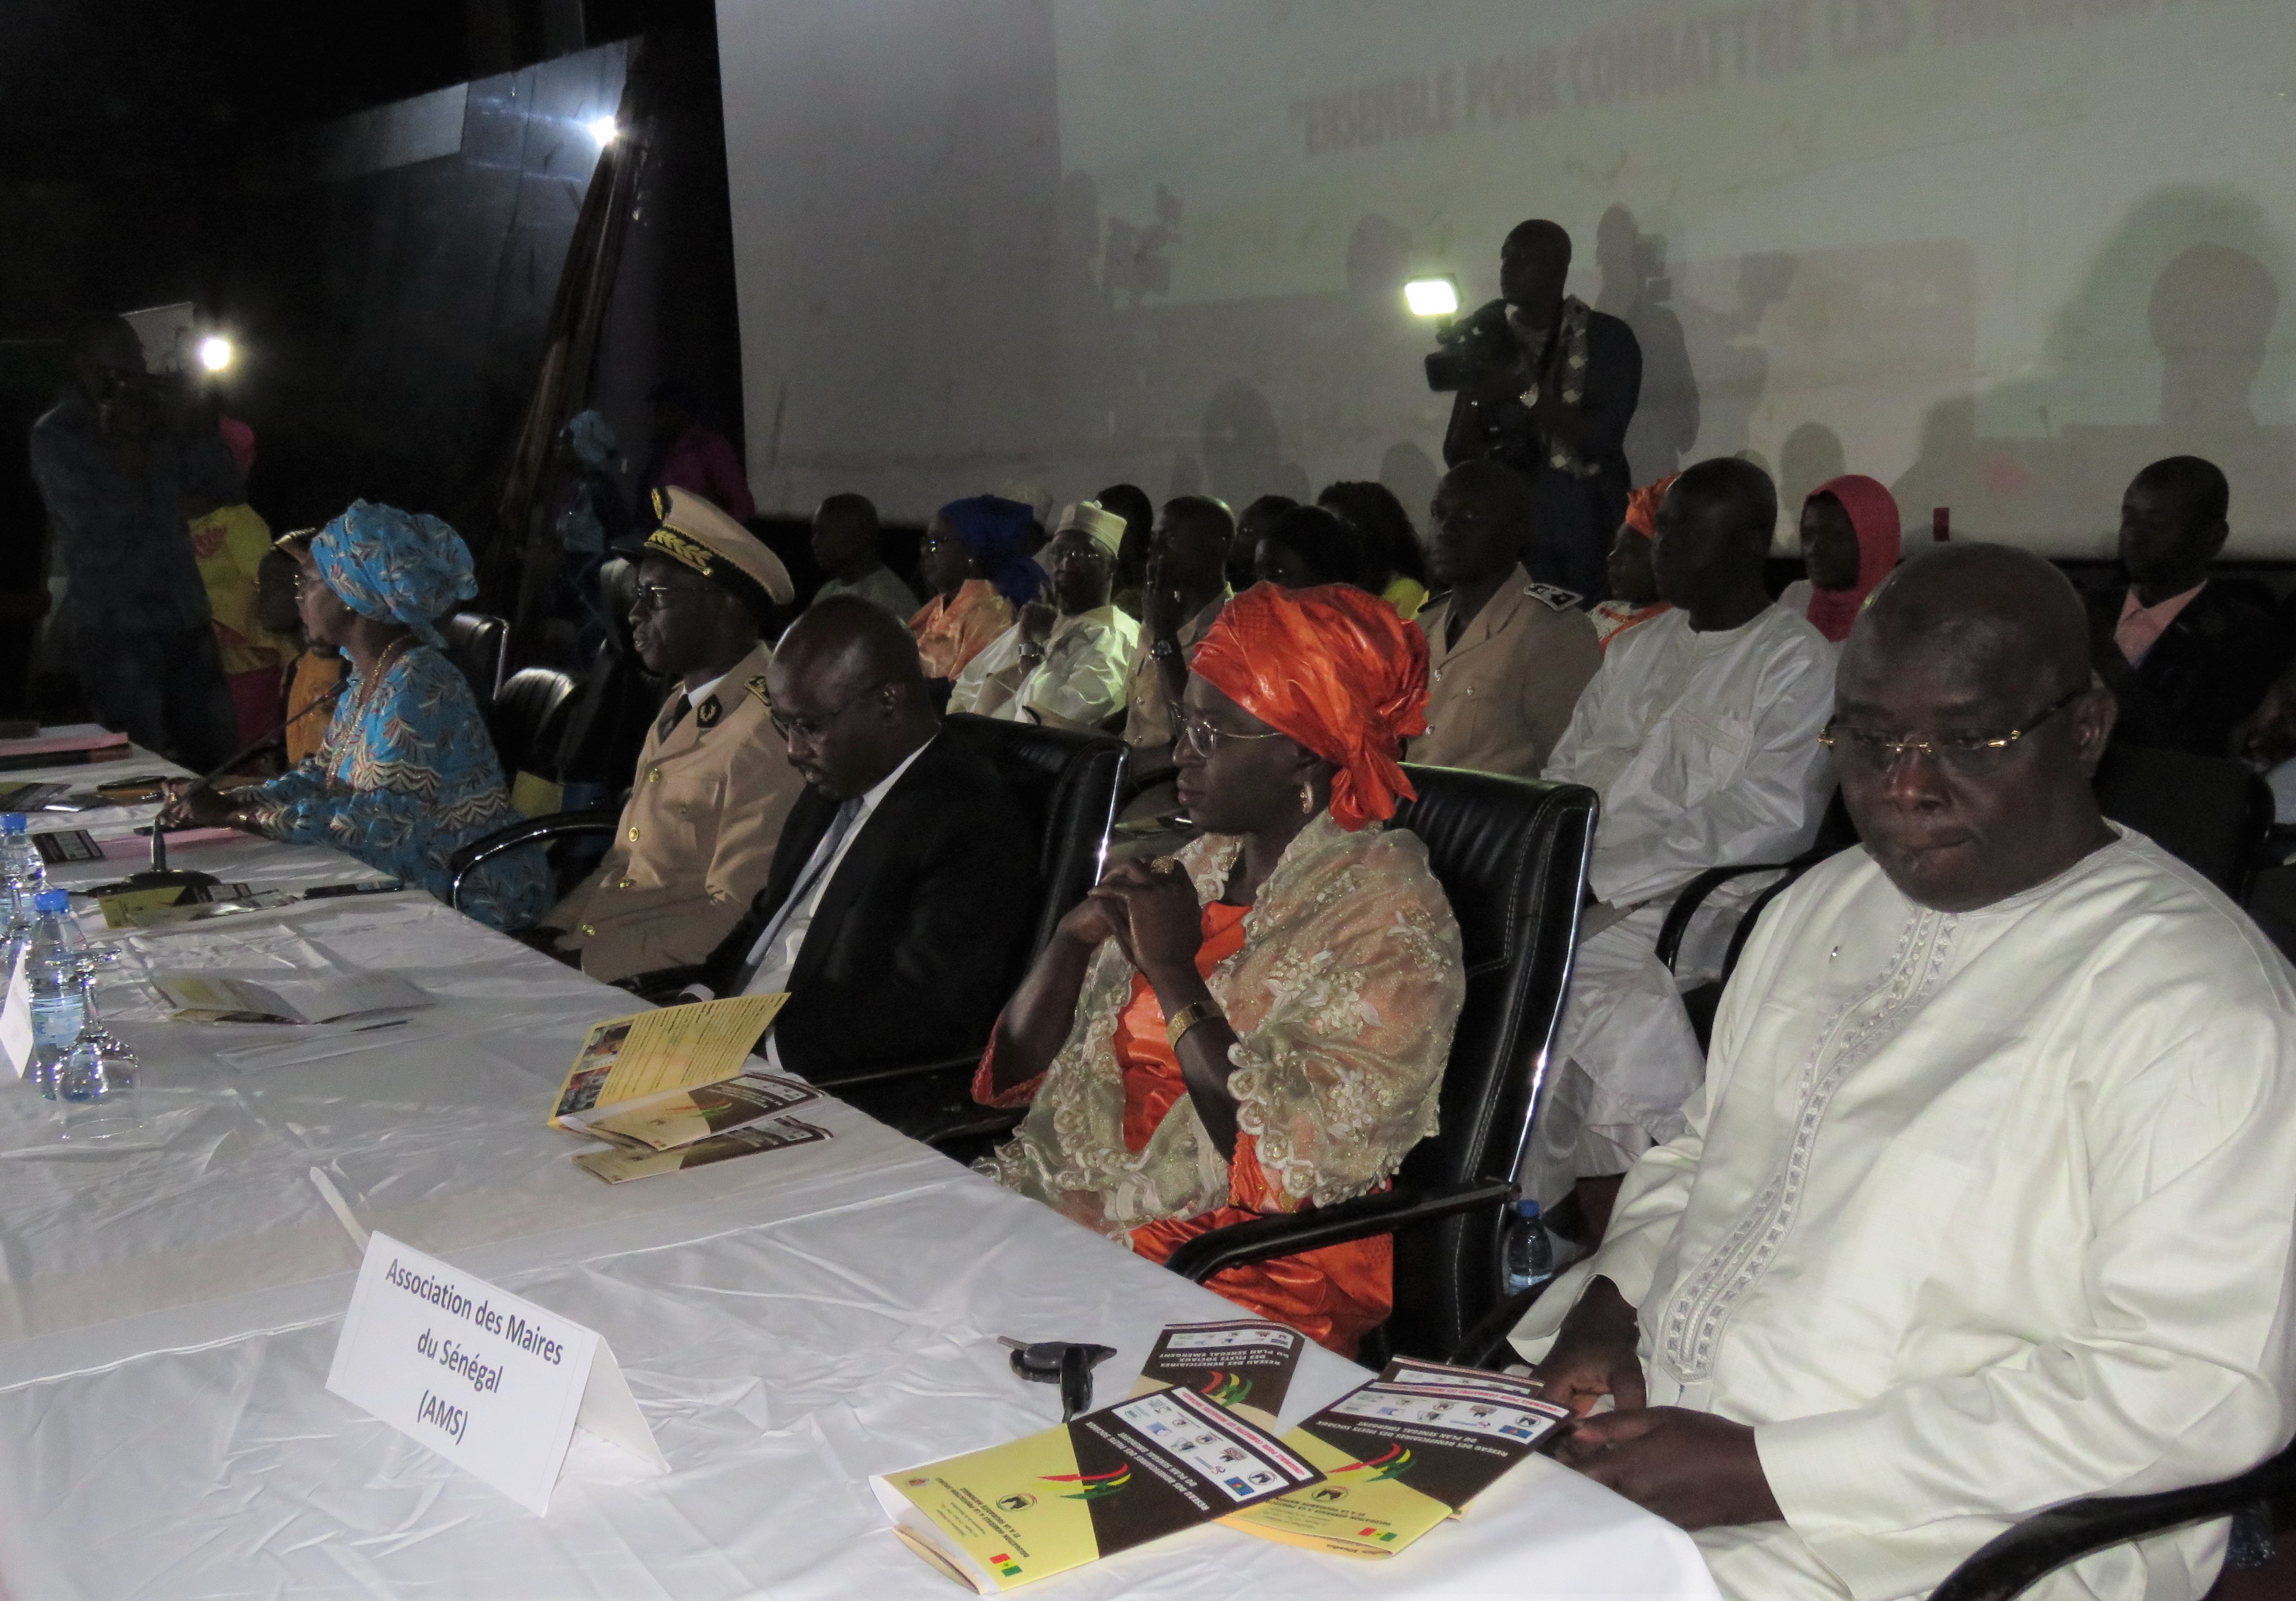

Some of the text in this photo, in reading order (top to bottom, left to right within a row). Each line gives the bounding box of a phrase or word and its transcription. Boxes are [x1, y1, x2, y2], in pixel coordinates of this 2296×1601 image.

[386, 1259, 563, 1365] Association des Maires
[418, 1328, 503, 1393] du Sénégal
[418, 1389, 468, 1445] (AMS)
